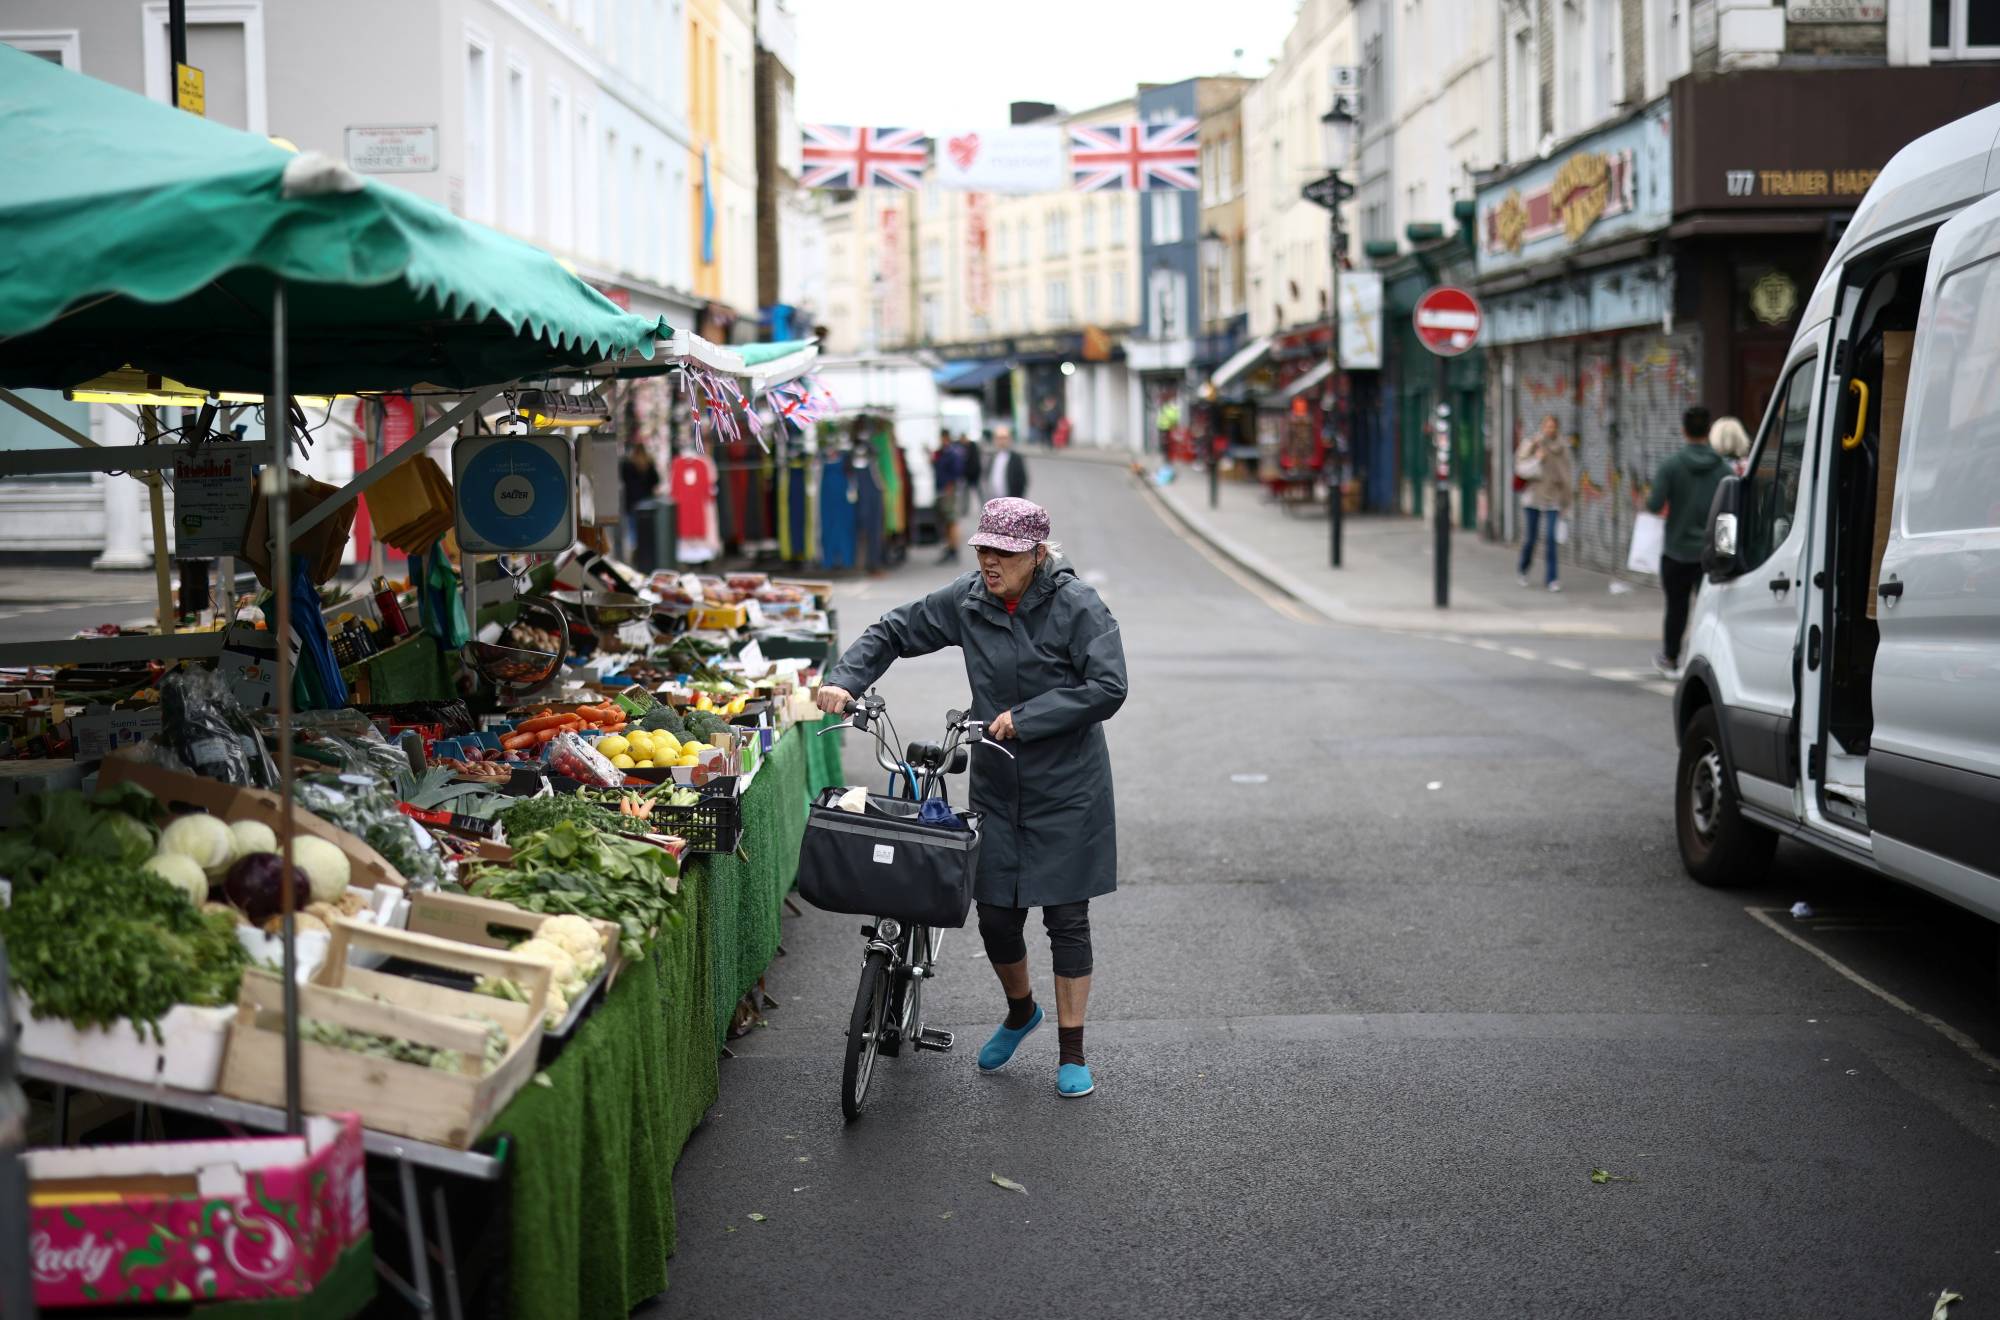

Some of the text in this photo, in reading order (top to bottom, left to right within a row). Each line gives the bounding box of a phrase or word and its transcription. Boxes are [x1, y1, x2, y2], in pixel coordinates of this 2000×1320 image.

[1726, 170, 1755, 196] 177
[1760, 170, 1829, 195] TRAILER
[500, 489, 528, 500] SALTER
